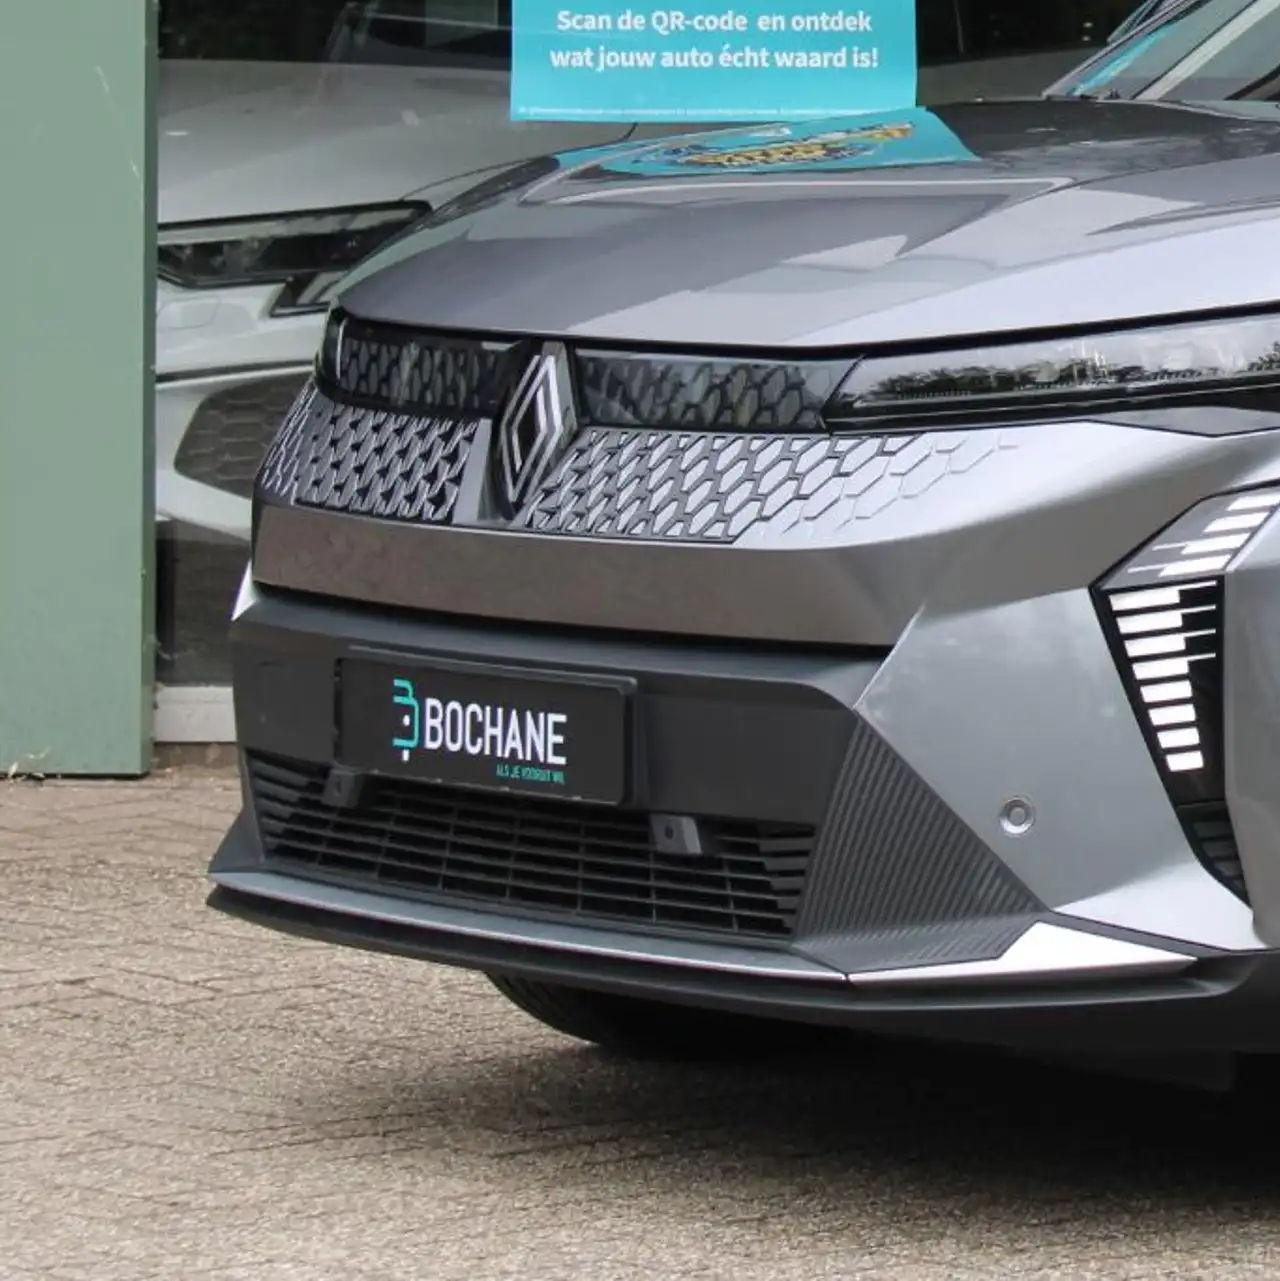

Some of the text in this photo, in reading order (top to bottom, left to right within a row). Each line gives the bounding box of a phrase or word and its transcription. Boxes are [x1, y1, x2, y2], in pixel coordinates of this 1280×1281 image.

[556, 10, 872, 35] Scan de QR-code en ontdek
[550, 44, 879, 72] wat jouw auto écht waard is!
[425, 697, 567, 765] BOCHANE
